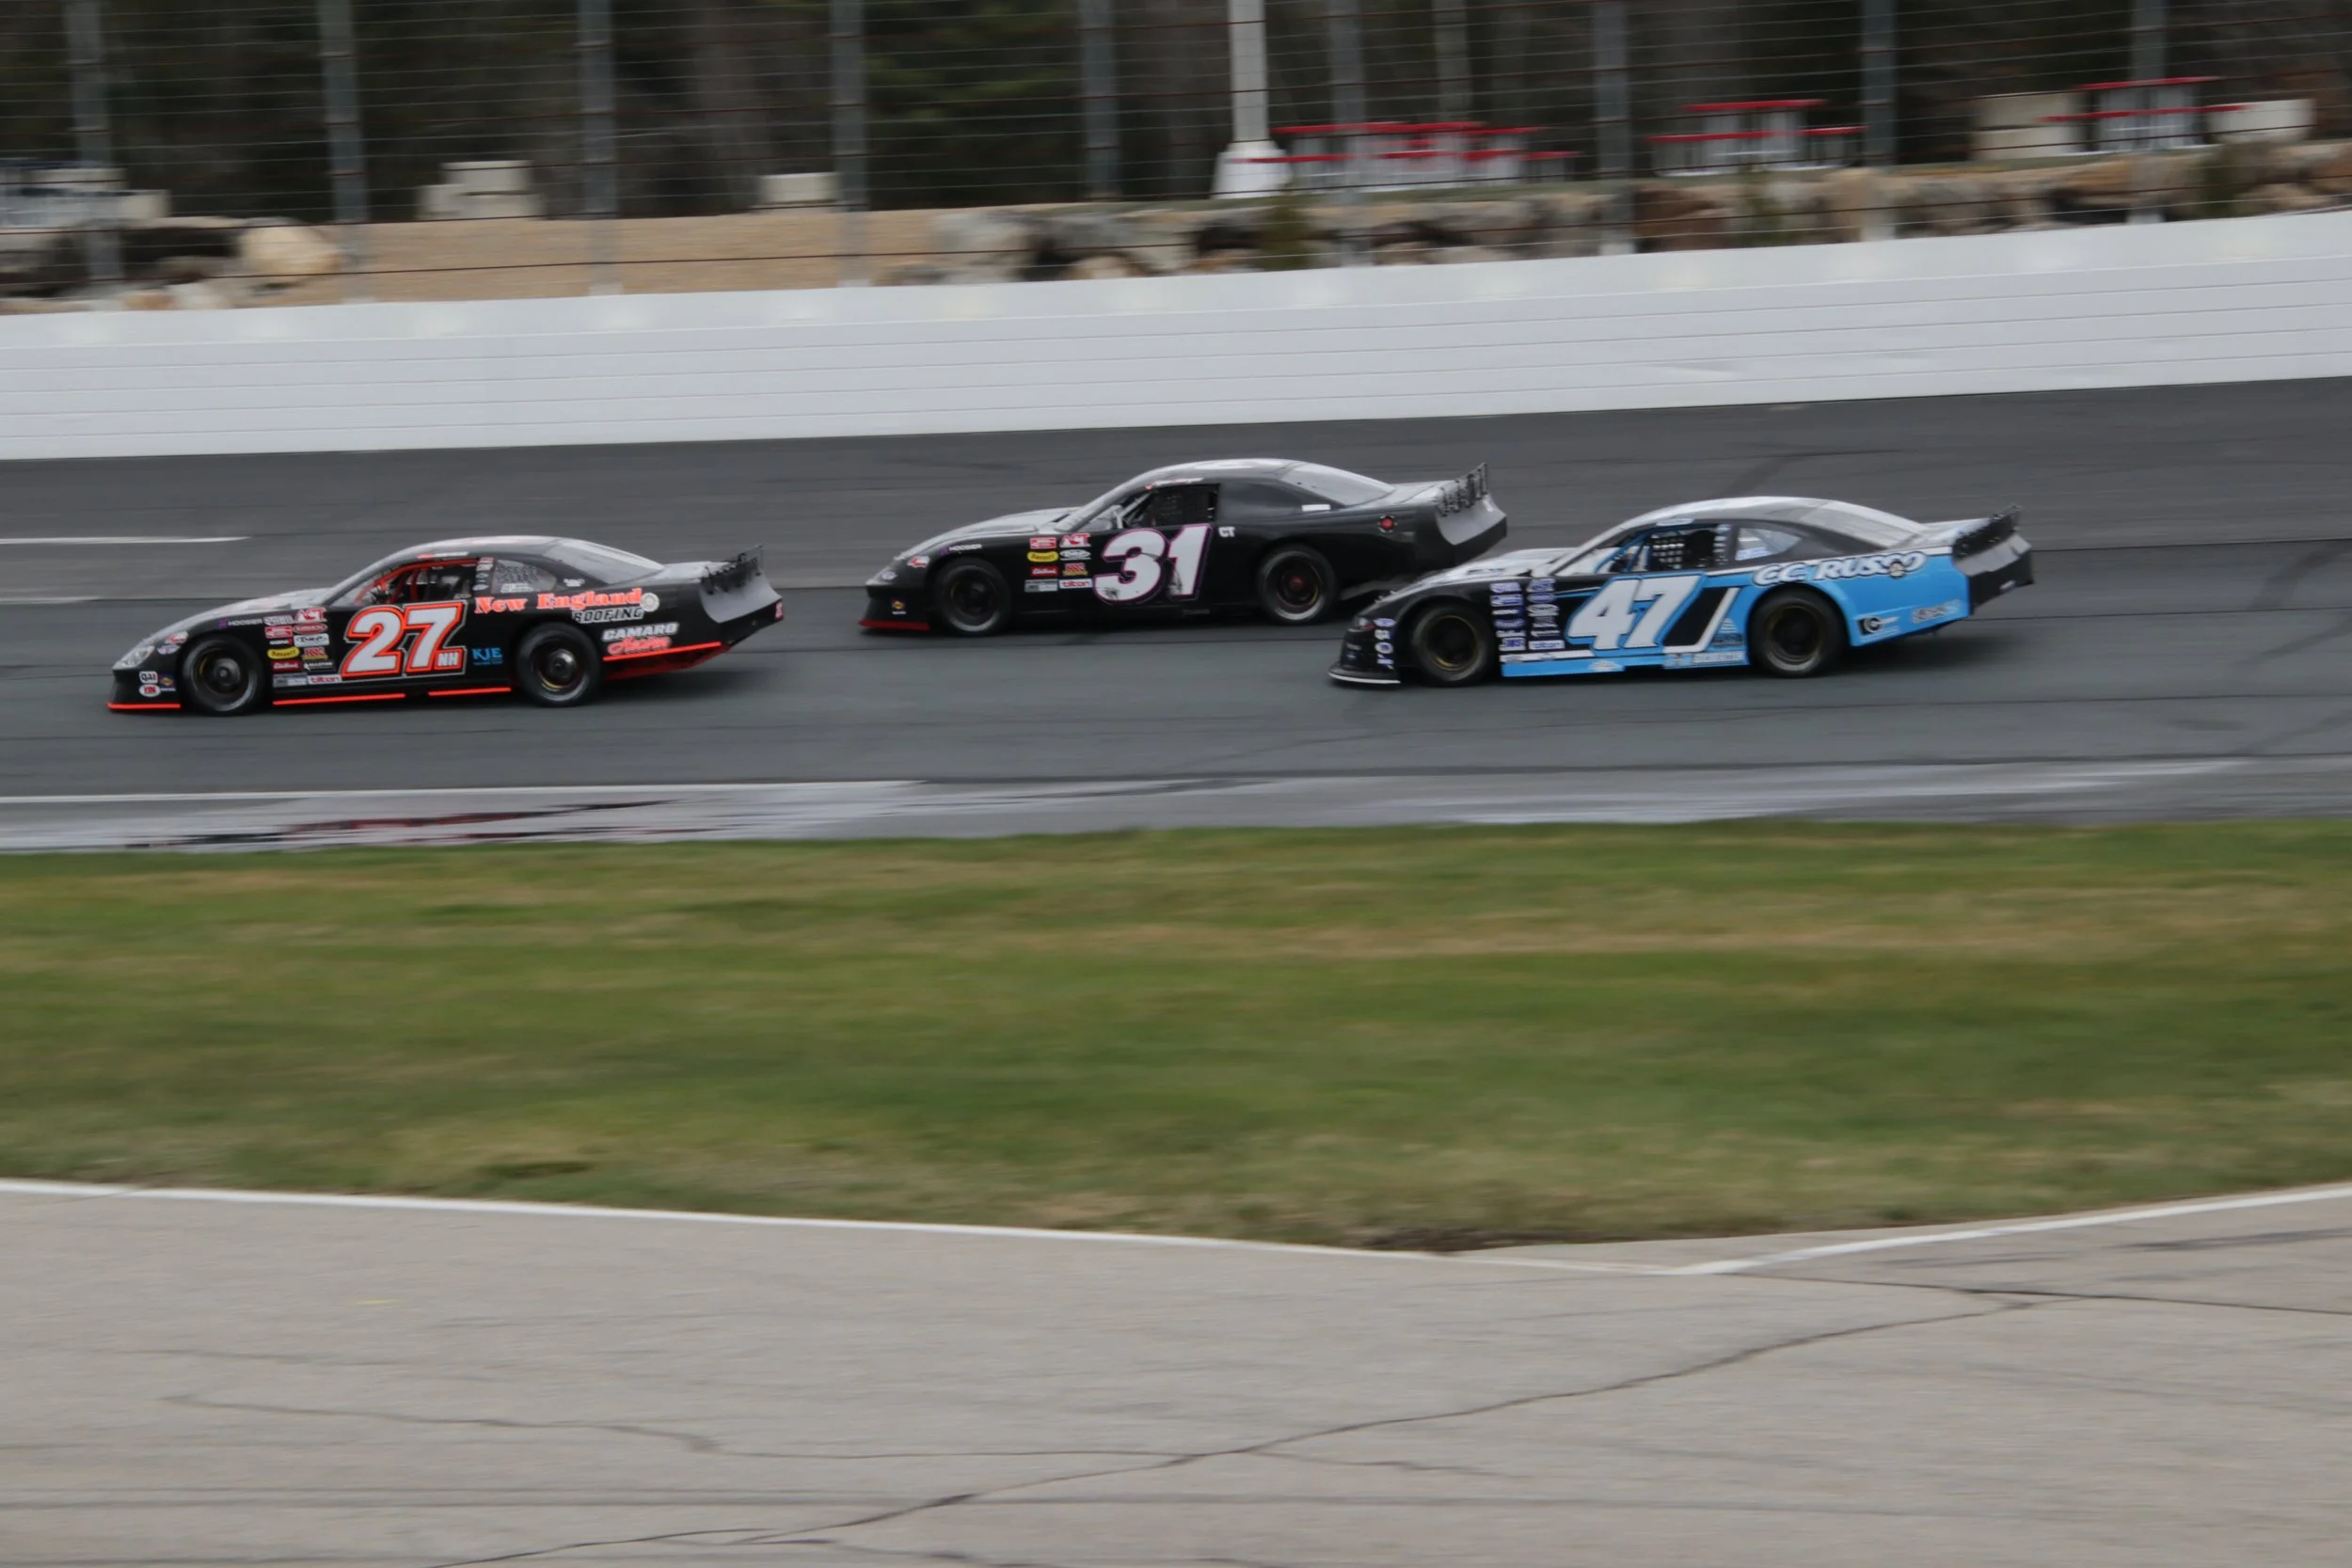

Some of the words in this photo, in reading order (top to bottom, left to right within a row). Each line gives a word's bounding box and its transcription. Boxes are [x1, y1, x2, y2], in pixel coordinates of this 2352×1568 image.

[1219, 526, 1236, 537] CT
[1091, 523, 1213, 604] 31
[474, 596, 528, 614] New
[536, 587, 643, 610] England
[572, 606, 645, 624] ROOFING
[1565, 573, 1701, 657] 47
[342, 600, 466, 678] 27
[602, 622, 679, 641] CAMARO
[437, 652, 459, 667] NH
